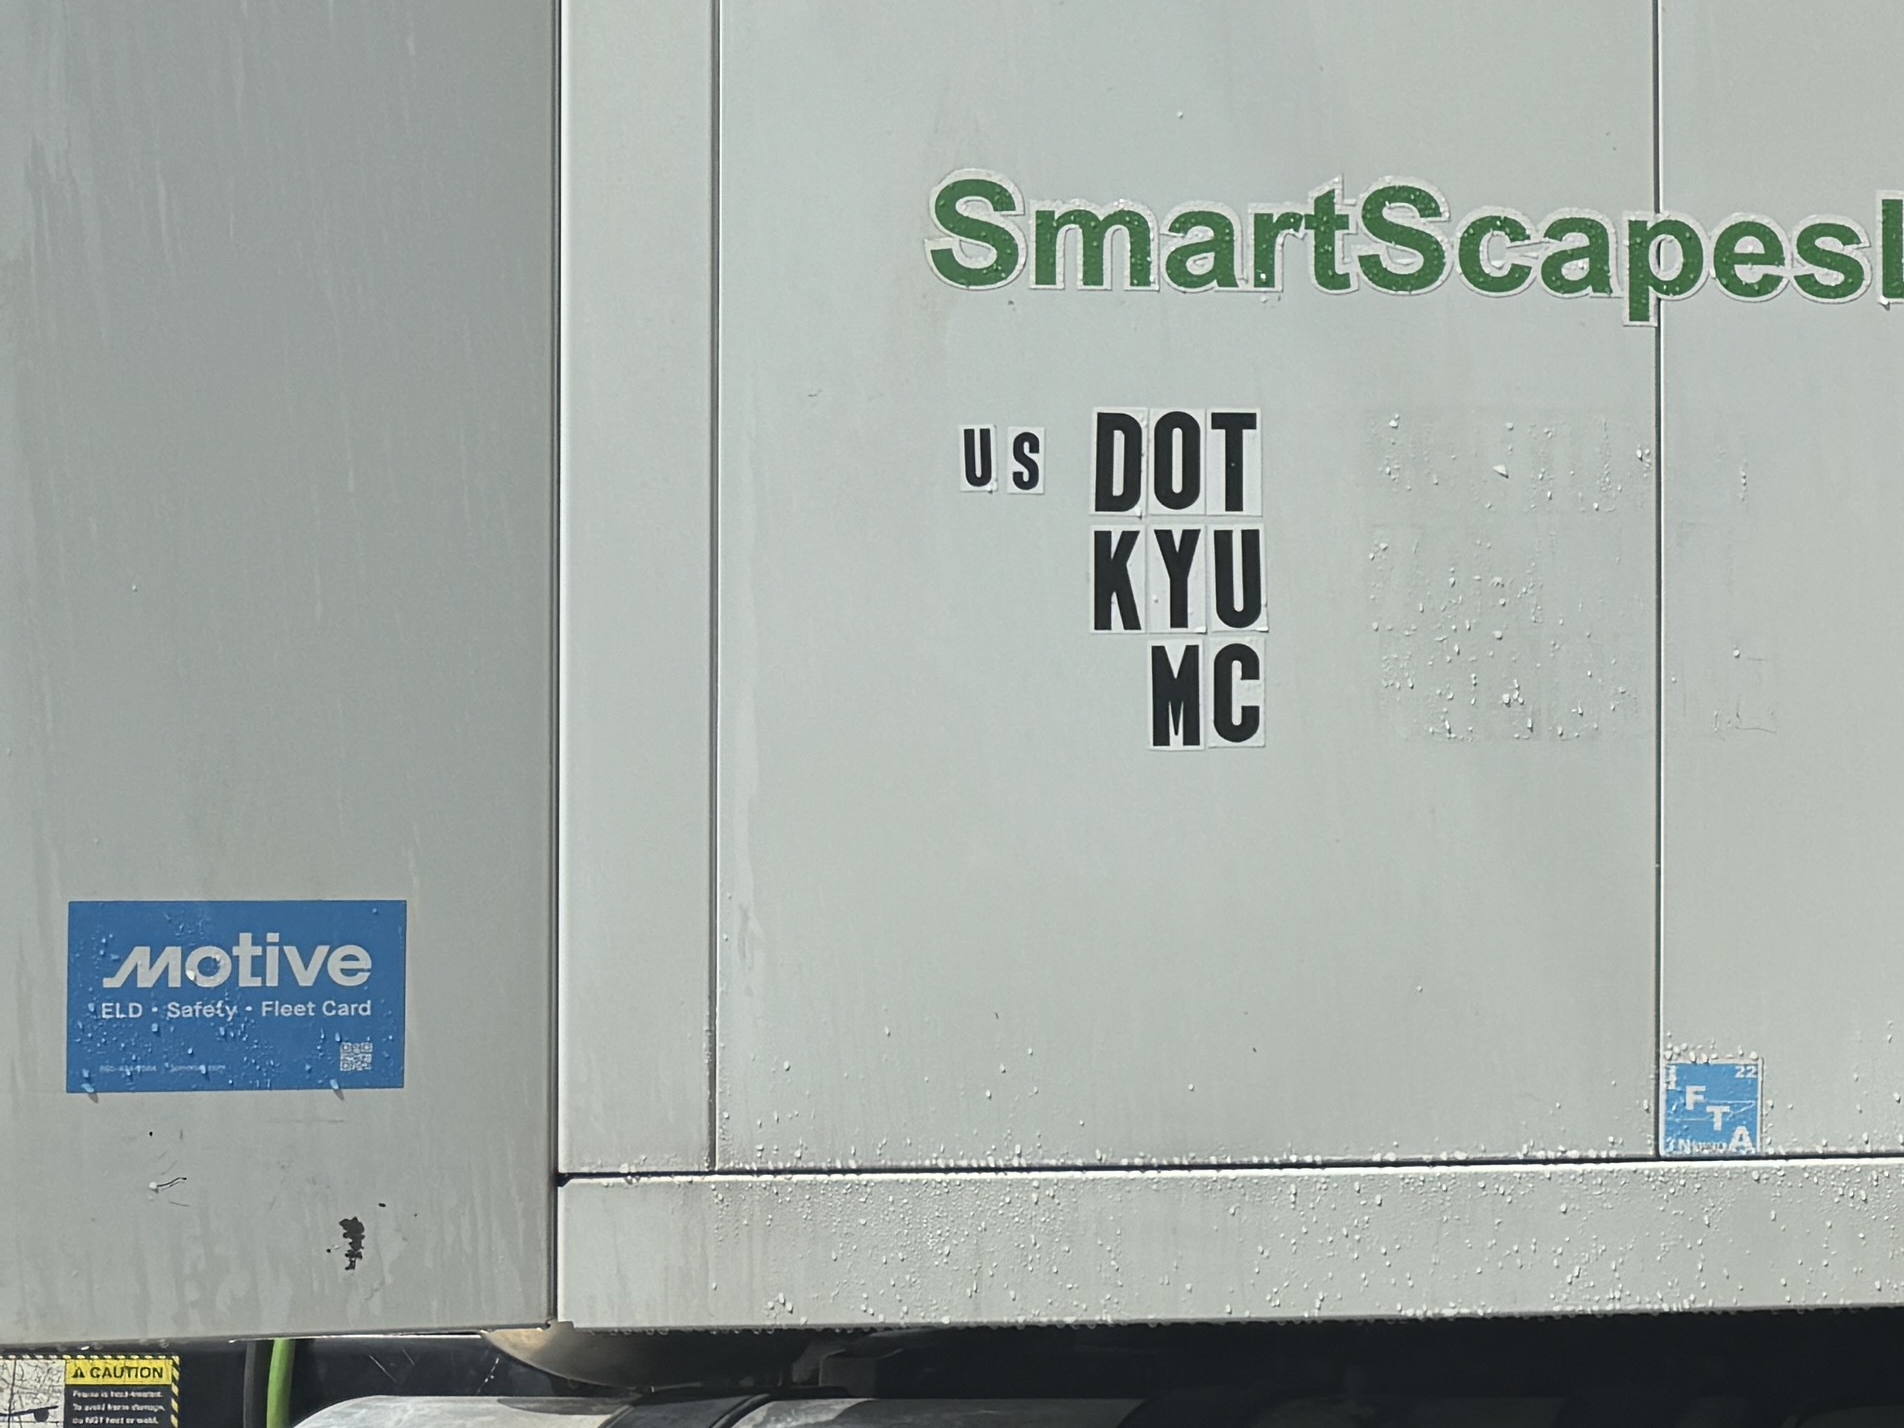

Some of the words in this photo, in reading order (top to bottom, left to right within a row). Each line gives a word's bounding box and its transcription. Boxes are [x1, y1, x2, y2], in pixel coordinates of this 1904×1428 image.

[1094, 411, 1257, 512] DOT
[1093, 528, 1262, 631] KYU
[1152, 643, 1260, 747] MC
[101, 1003, 143, 1019] ELD
[167, 1001, 238, 1021] Safety
[261, 1001, 316, 1017] Fleet
[322, 1000, 372, 1016] Card
[1734, 1065, 1757, 1079] 22
[90, 1366, 163, 1378] CAUTION
